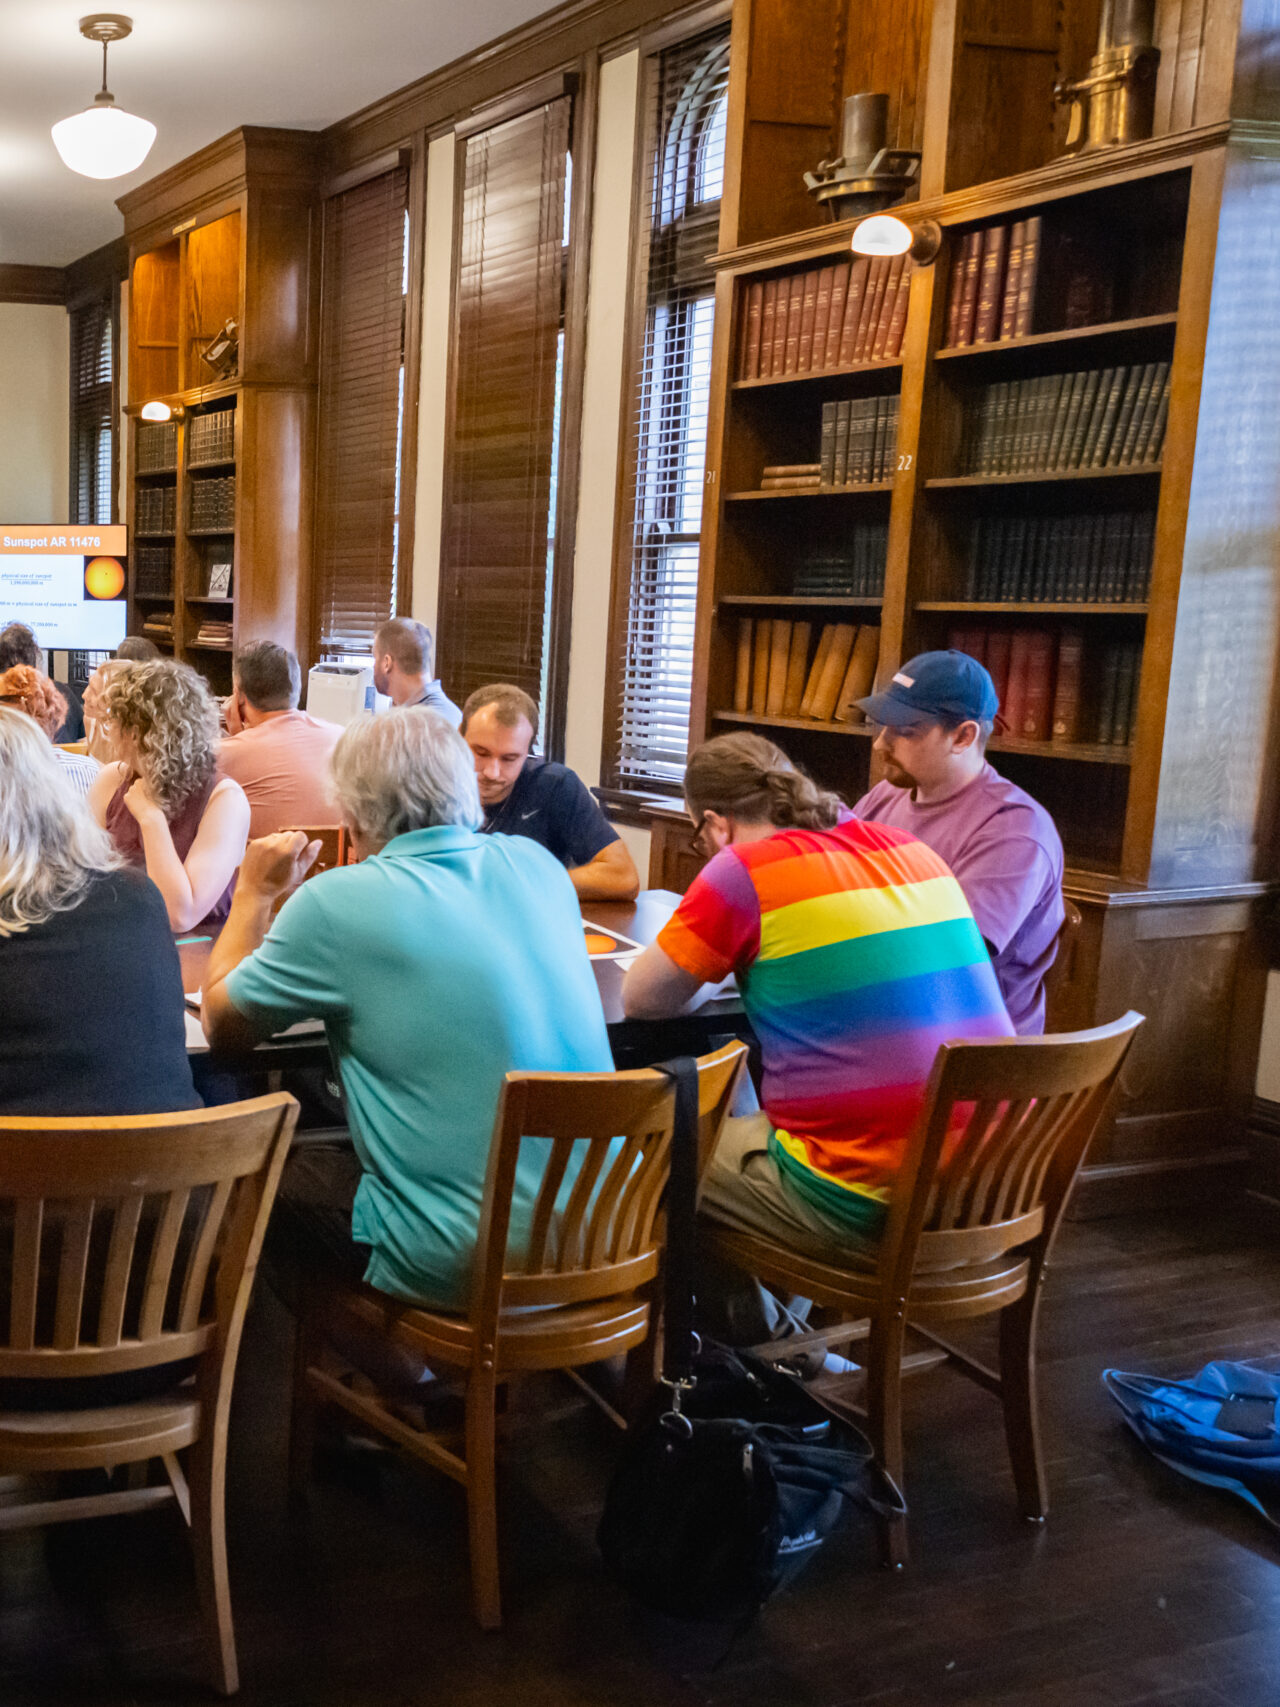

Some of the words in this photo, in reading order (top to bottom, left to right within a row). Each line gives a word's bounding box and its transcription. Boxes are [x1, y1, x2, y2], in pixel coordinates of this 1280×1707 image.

[897, 454, 913, 471] 22
[706, 470, 717, 484] 21
[3, 535, 48, 549] Sunspot
[50, 536, 67, 547] AR
[69, 536, 101, 547] 11476
